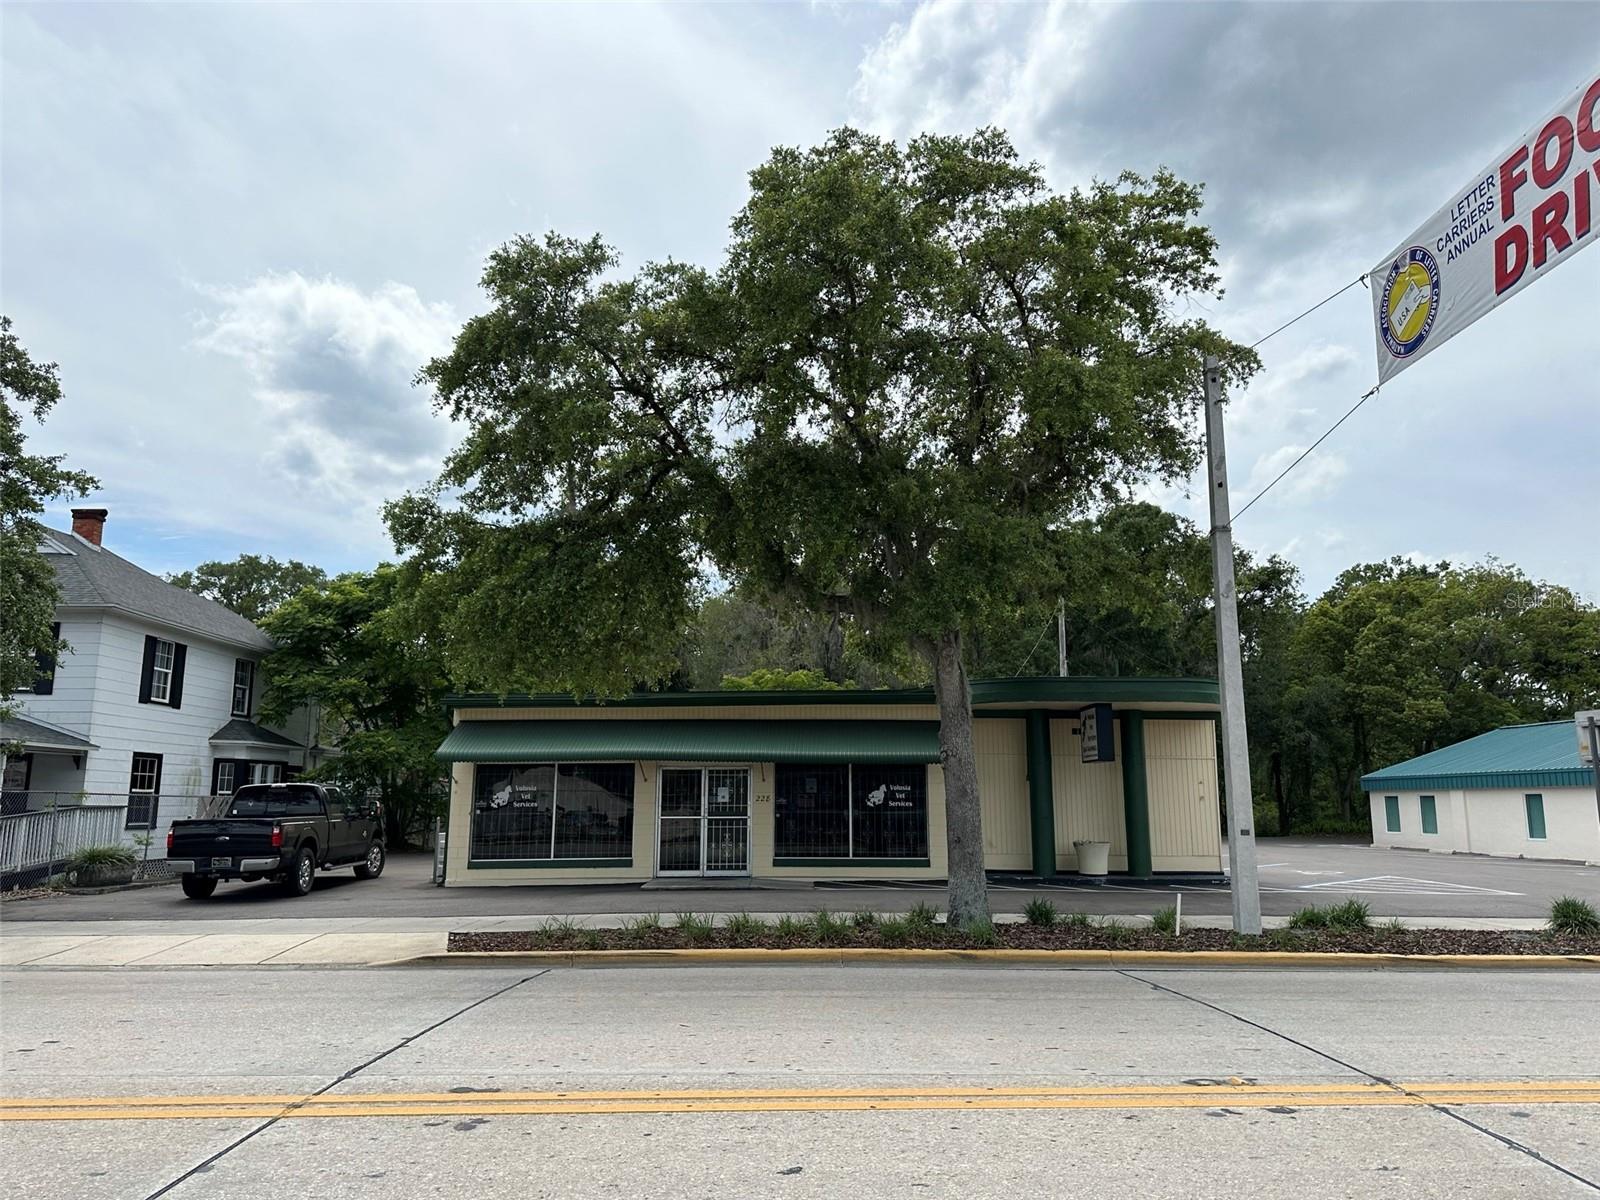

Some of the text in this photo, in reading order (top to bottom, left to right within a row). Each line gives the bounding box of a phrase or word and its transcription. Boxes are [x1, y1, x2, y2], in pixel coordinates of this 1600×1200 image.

[1450, 174, 1496, 223] LETTER
[1436, 195, 1495, 253] CARRIERS
[1446, 217, 1495, 265] ANNUAL
[1494, 158, 1600, 297] DRI
[1415, 249, 1424, 261] OF
[1424, 254, 1439, 284] LETTER
[1381, 270, 1397, 329] ASSOCIATION
[1397, 306, 1411, 327] USA
[1421, 288, 1439, 337] CARRIERS
[512, 800, 538, 808] Services
